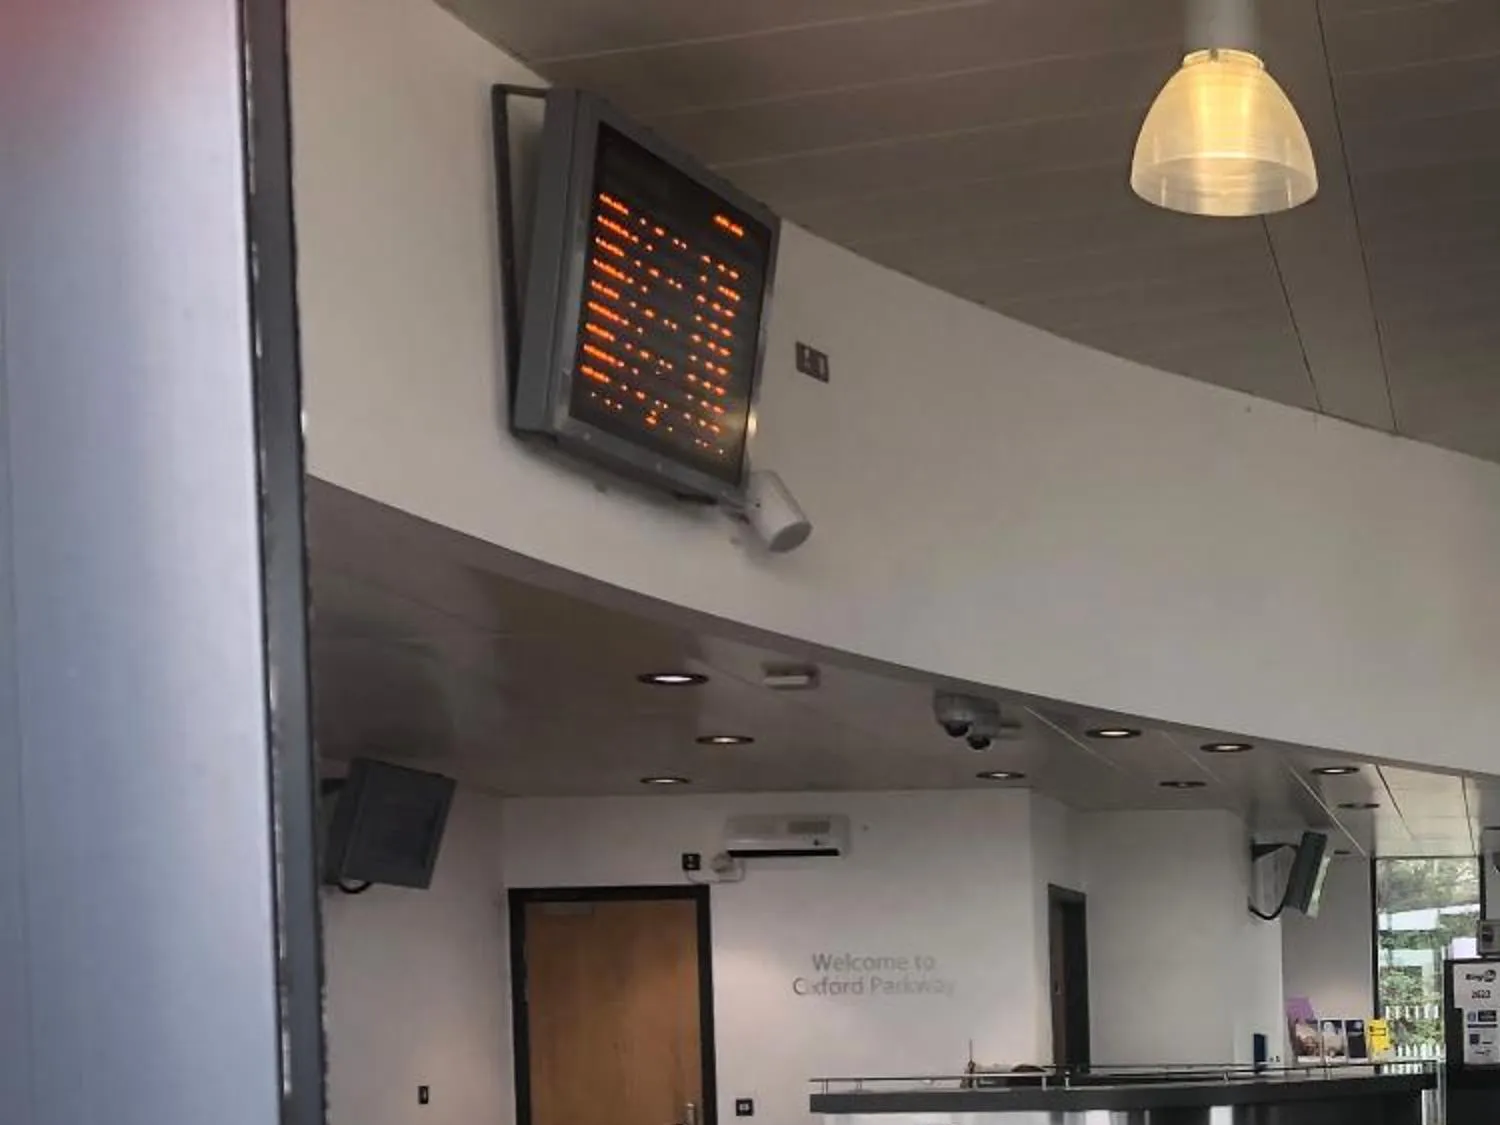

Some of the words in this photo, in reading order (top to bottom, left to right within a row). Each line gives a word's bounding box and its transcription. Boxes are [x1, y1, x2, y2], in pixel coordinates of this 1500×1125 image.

[812, 952, 909, 972] Welcome
[915, 954, 936, 972] to
[793, 976, 864, 996] Oxford
[871, 976, 957, 998] Parkway
